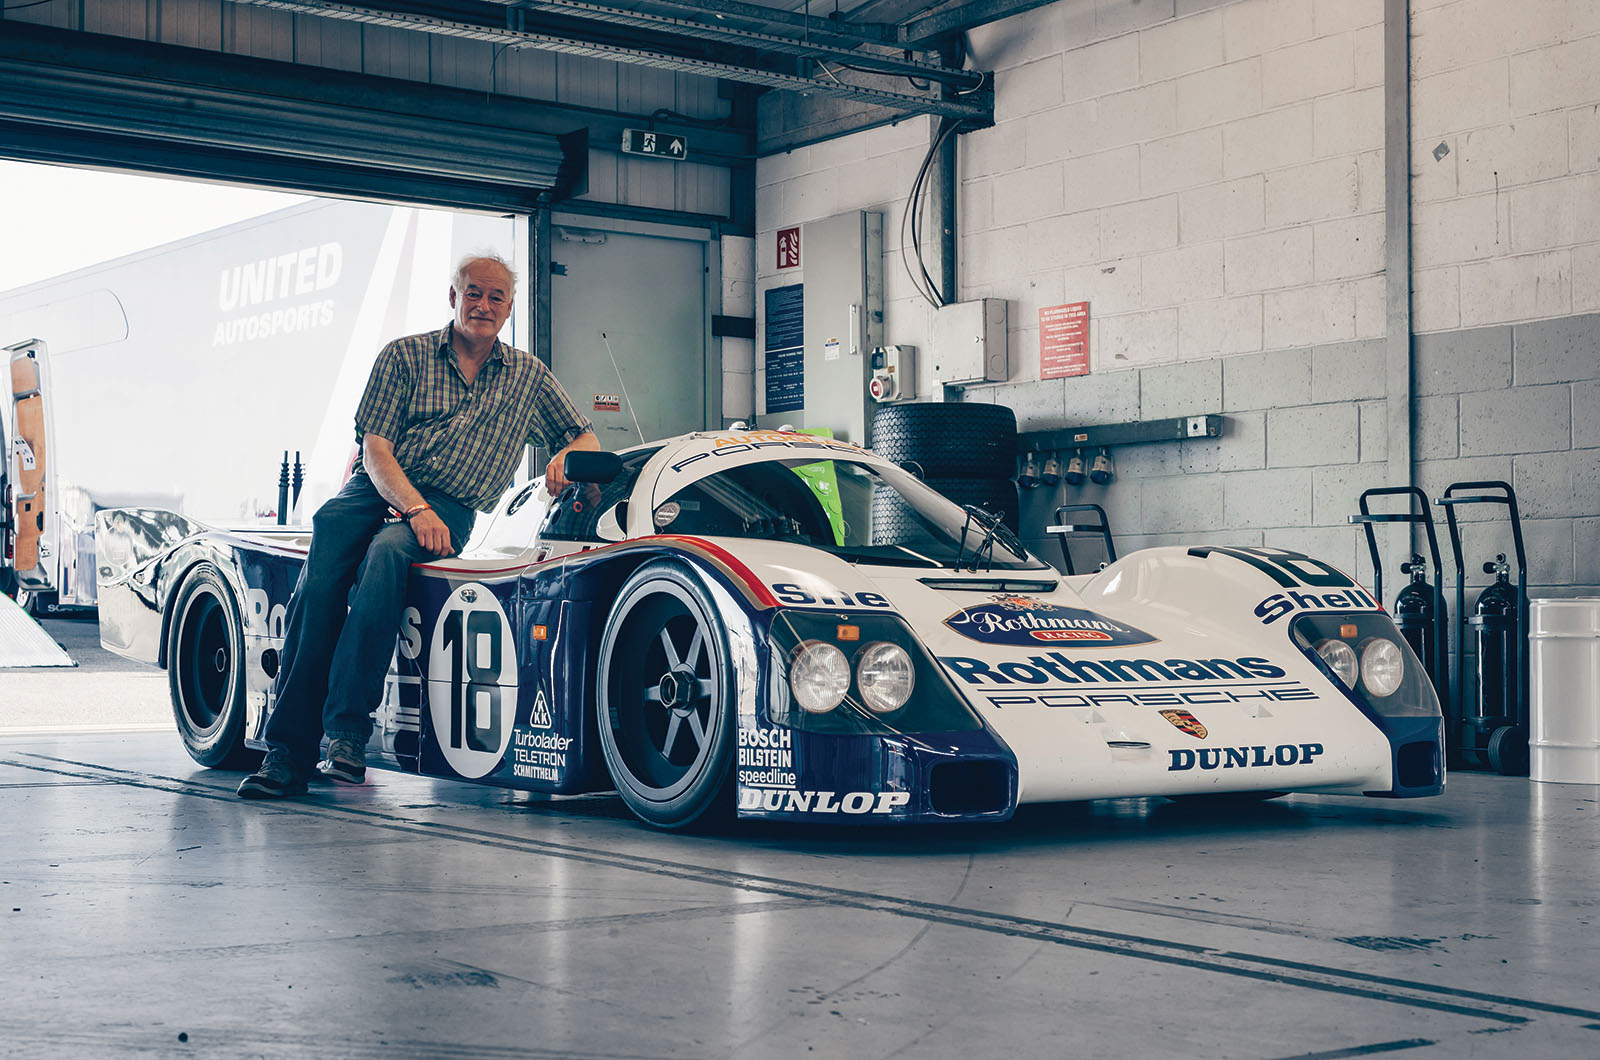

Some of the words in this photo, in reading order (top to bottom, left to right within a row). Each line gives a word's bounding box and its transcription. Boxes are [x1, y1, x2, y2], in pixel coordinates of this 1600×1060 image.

[218, 241, 344, 312] UNITED
[211, 299, 335, 347] AUTOSPORTS
[1254, 590, 1376, 625] Shell
[971, 612, 1131, 634] Rothmans
[1041, 631, 1103, 641] RACING
[937, 652, 1287, 685] Rothmans
[443, 610, 503, 754] 18
[985, 687, 1320, 709] PORSCHE
[514, 729, 573, 751] Turbolader
[738, 728, 791, 749] BOSCH
[514, 748, 566, 767] TELETRON
[738, 748, 792, 768] BILSTEIN
[1168, 742, 1324, 772] DUNLOP
[513, 763, 559, 781] SCHMITTHELM
[738, 769, 797, 787] speedline
[737, 787, 911, 815] DUNLOP
